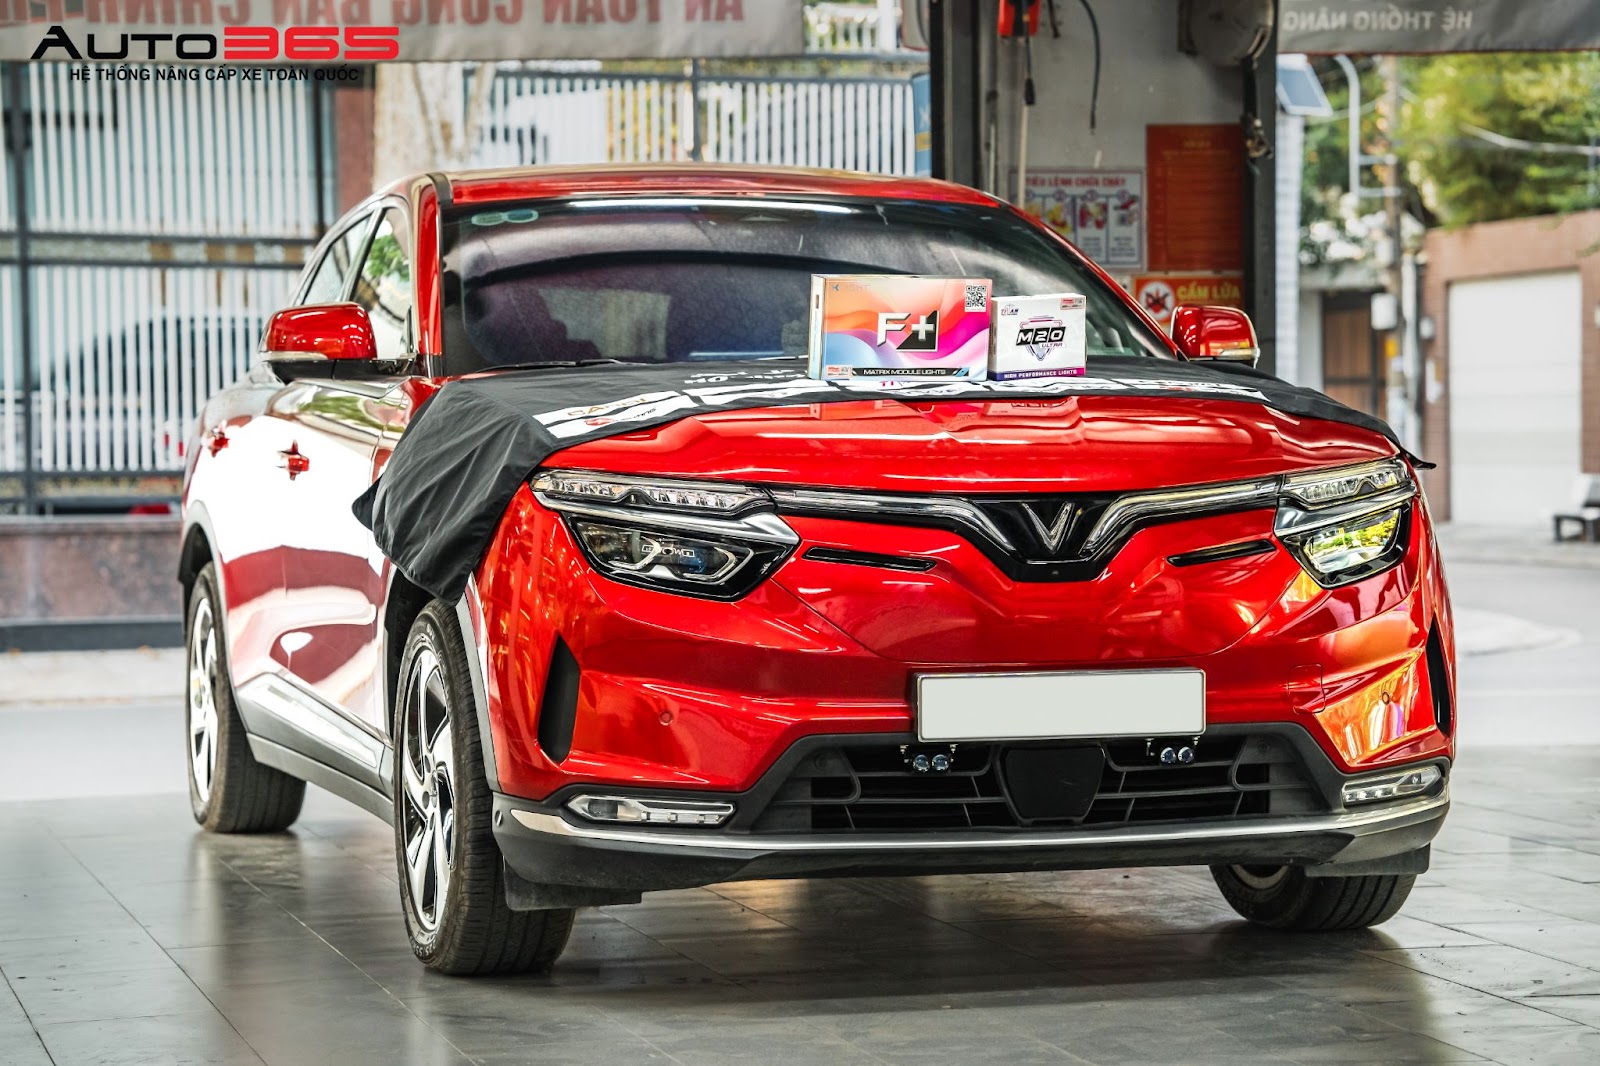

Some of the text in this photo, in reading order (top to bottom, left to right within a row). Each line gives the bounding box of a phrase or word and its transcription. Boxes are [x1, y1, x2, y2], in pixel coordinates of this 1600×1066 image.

[1177, 281, 1209, 300] CẤM
[877, 311, 938, 348] F+
[1017, 331, 1064, 345] M20
